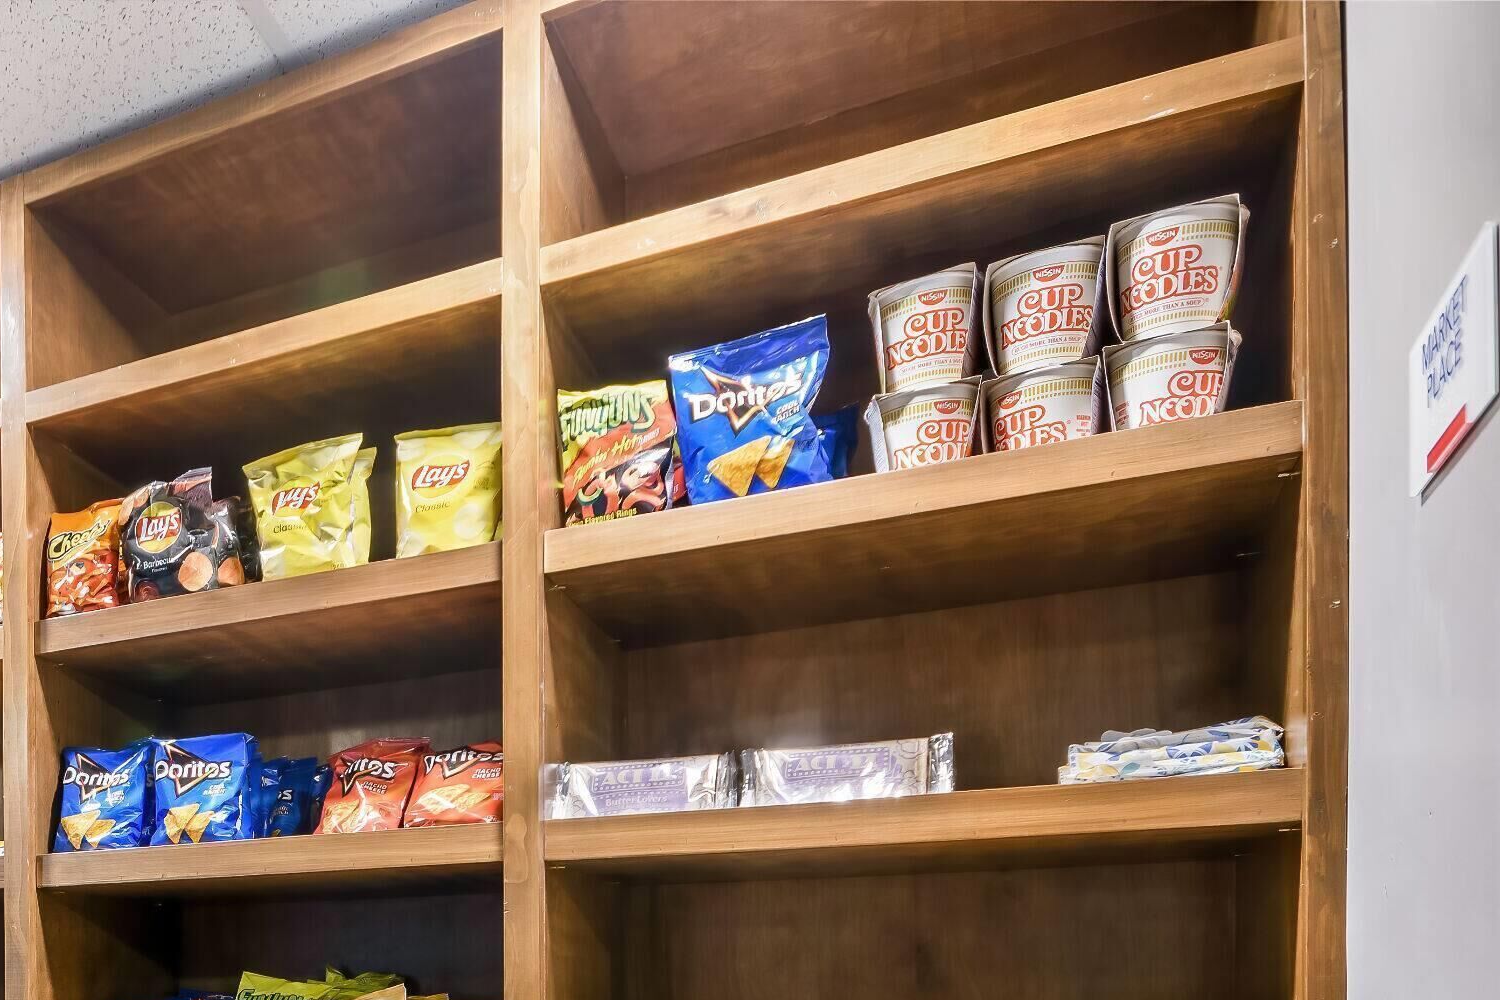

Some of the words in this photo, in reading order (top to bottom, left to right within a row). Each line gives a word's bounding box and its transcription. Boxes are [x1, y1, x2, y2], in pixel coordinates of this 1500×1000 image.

[1149, 230, 1177, 243] NISSIN
[1035, 267, 1062, 279] NISSIN
[1133, 245, 1202, 283] CUP
[921, 292, 946, 302] NISSIN
[1017, 283, 1083, 316] CUP
[1121, 266, 1218, 318] NOODLES
[1163, 302, 1179, 311] THAN
[905, 308, 964, 338] CUP
[1002, 305, 1093, 349] NOODLES
[1422, 274, 1467, 374] MARKET
[888, 329, 967, 370] NOODLE
[1192, 351, 1216, 360] NISSIN
[1427, 328, 1462, 408] PLACE
[686, 372, 802, 420] Doritos
[937, 402, 959, 410] NISSIN
[995, 405, 1046, 440] CUP
[1140, 396, 1218, 426] NOOD
[917, 419, 971, 443] CUP
[616, 507, 637, 519] Rings
[156, 760, 232, 780] Doritos
[424, 750, 503, 775] Doritos
[795, 755, 838, 771] ACT
[63, 767, 130, 786] Doritos
[472, 772, 500, 780] CHEESE
[602, 769, 643, 785] ACT
